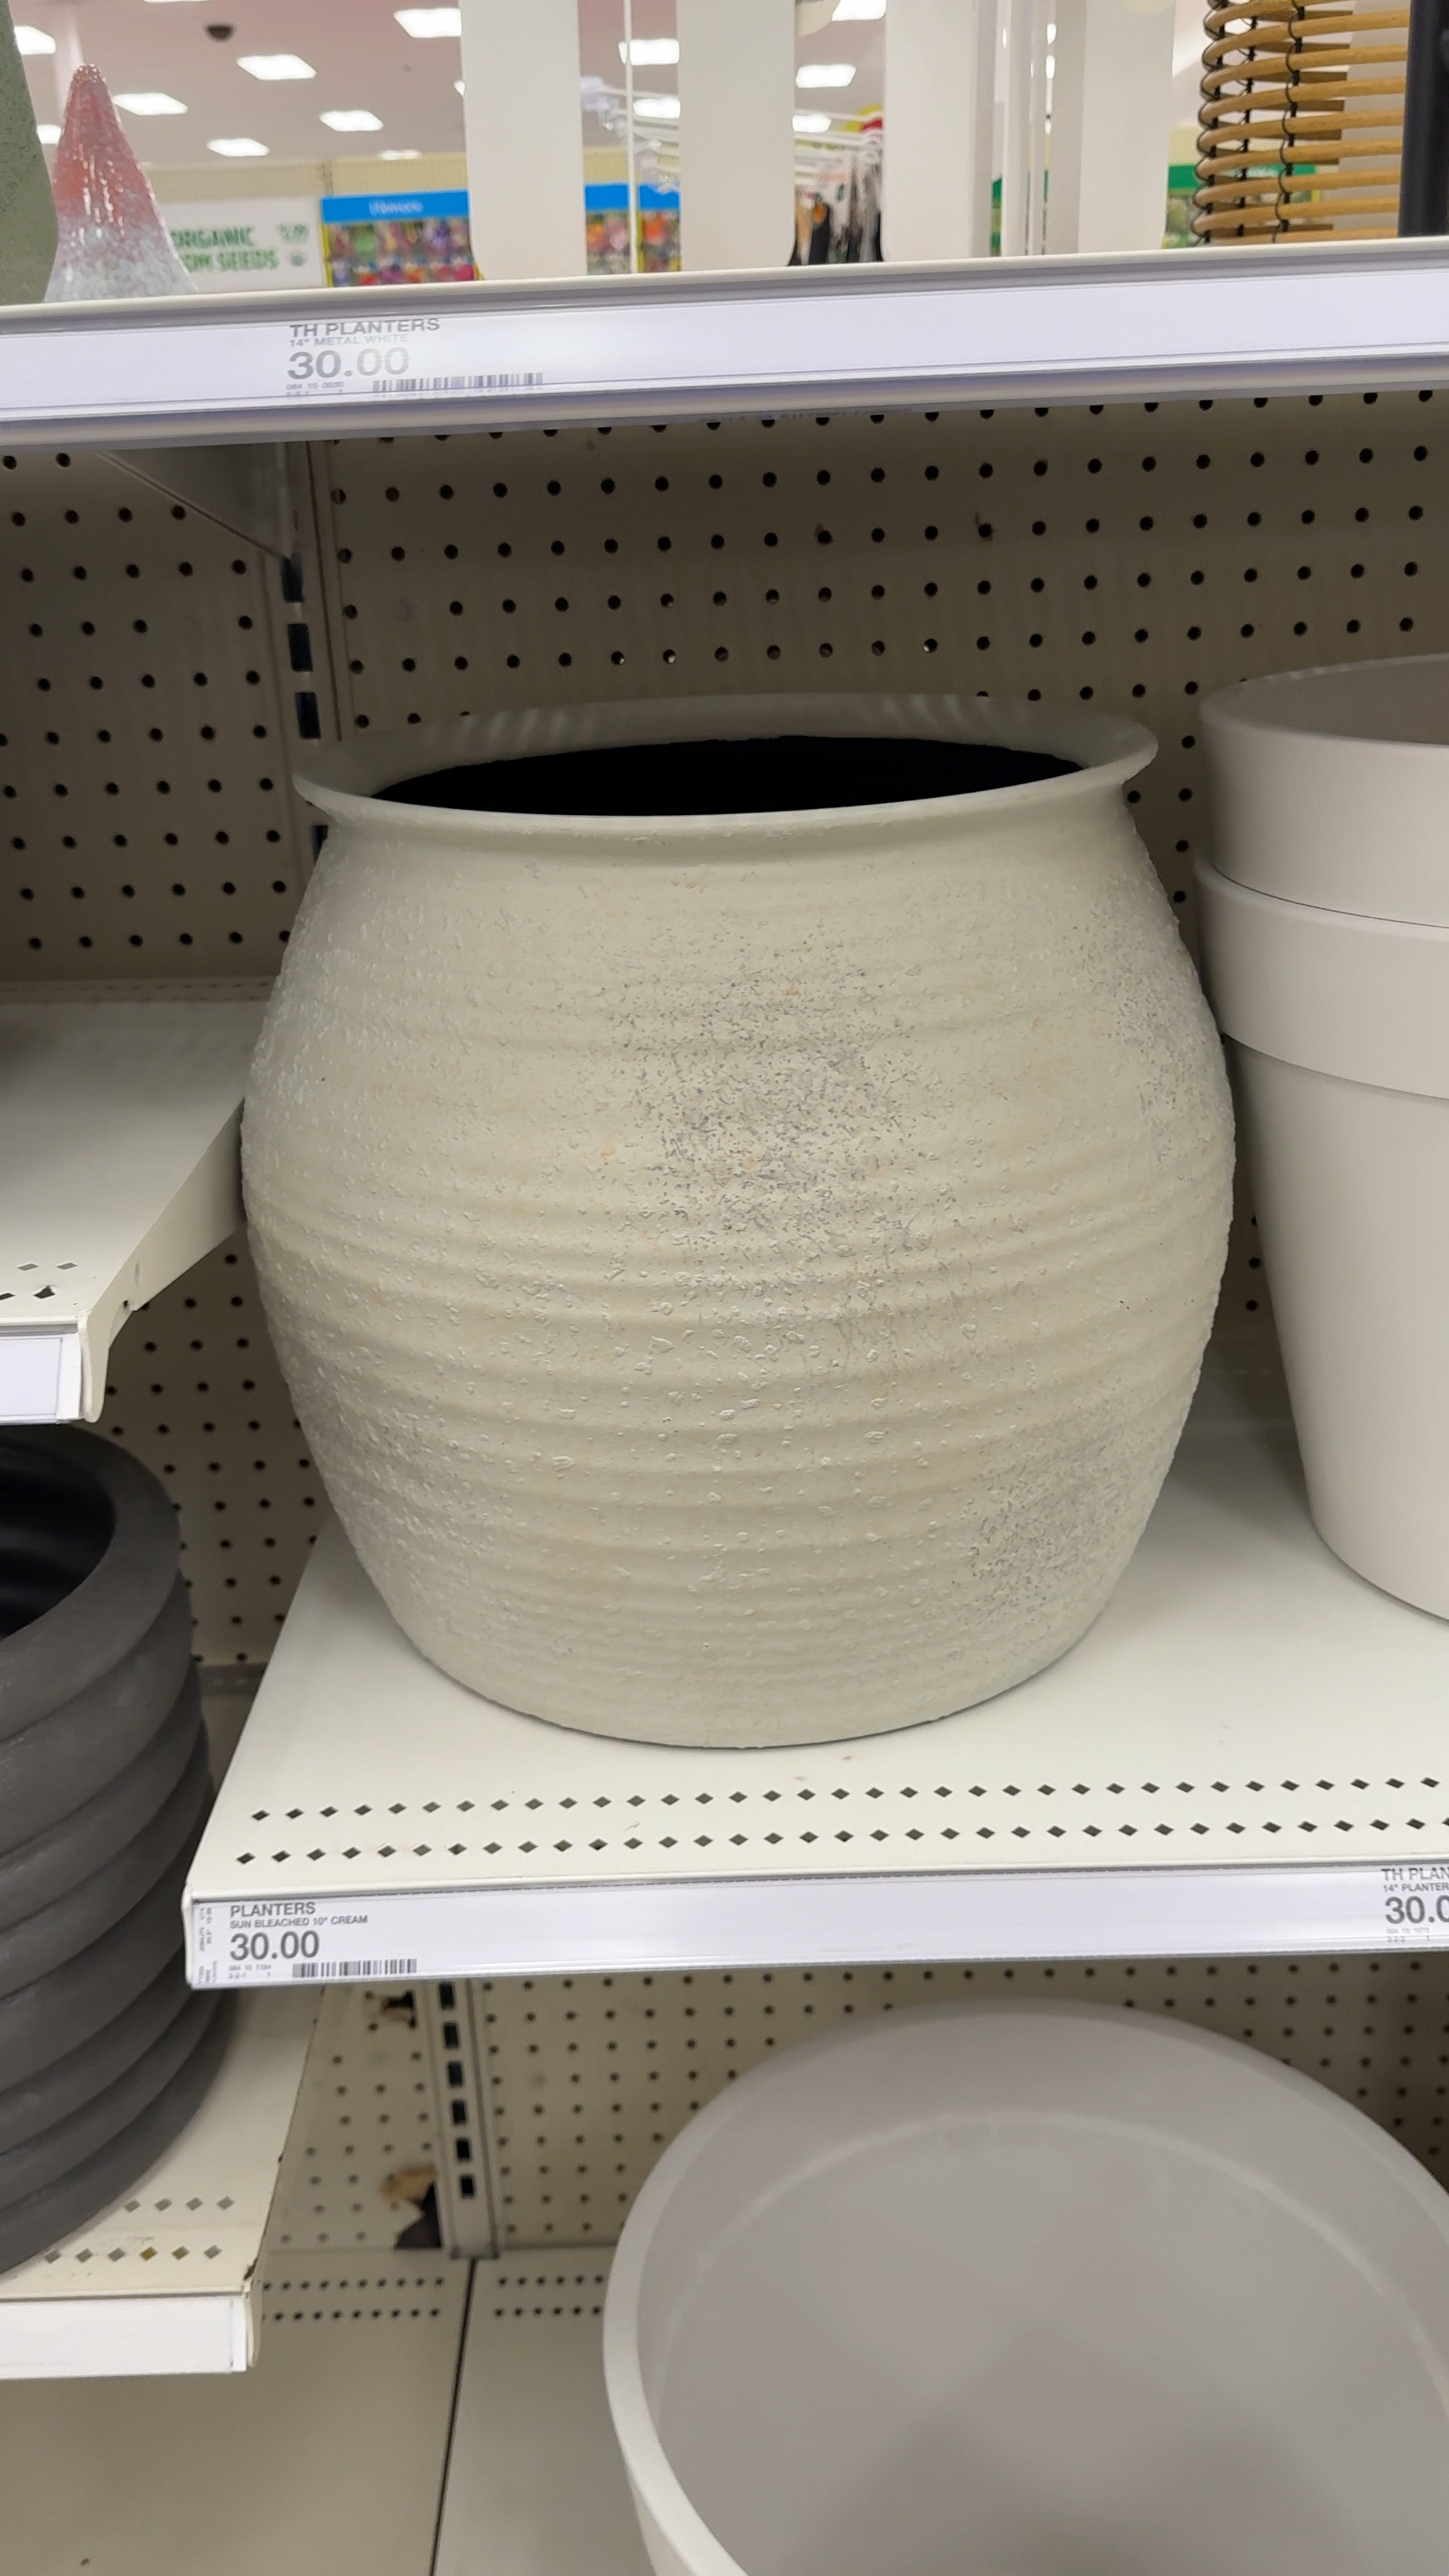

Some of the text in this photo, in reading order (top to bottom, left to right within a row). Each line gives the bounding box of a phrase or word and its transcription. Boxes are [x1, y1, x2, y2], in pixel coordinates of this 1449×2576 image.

[218, 249, 278, 271] SEEDS
[289, 318, 441, 337] TH PLANTERS
[290, 334, 409, 347] 14" METAL WHITE
[287, 347, 409, 380] 30.00
[1381, 1868, 1403, 1881] TH
[1383, 1882, 1449, 1892] 14" PLANTER
[230, 1902, 316, 1917] PLANTERS
[1385, 1895, 1449, 1924] 30.0
[230, 1915, 368, 1929] SUN BLEACHED 10" CREAM
[230, 1930, 319, 1960] 30.00
